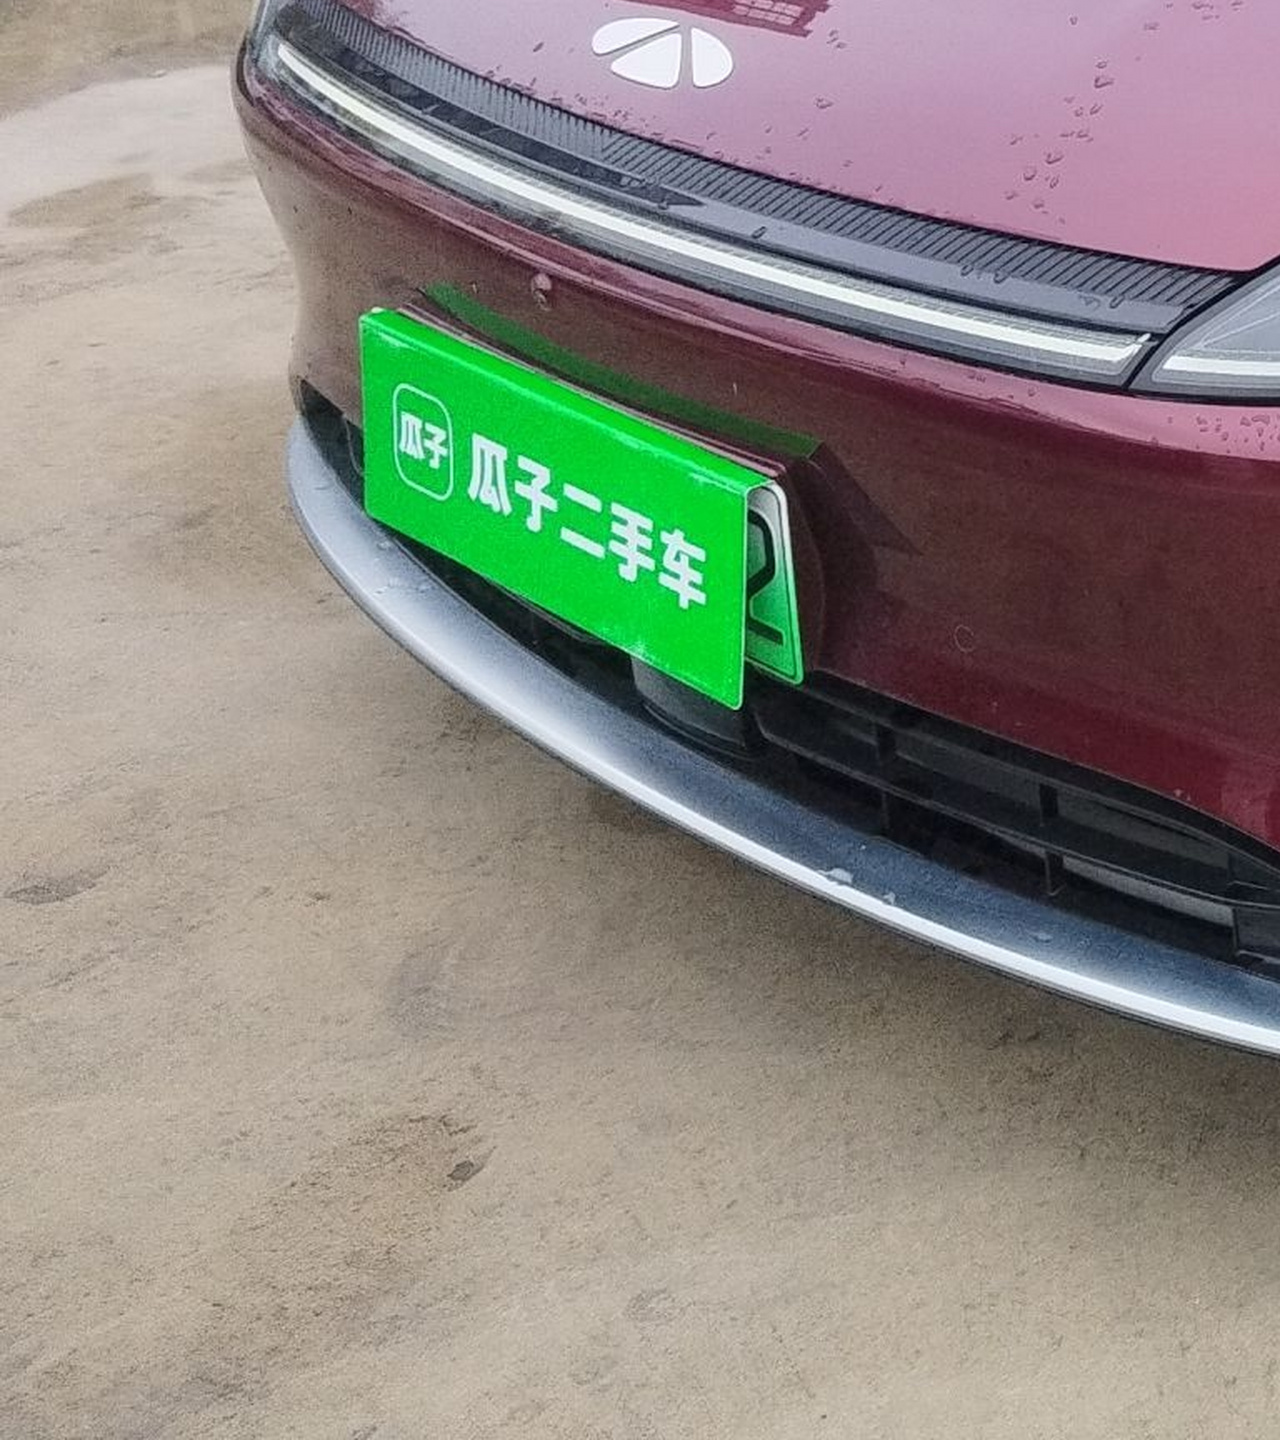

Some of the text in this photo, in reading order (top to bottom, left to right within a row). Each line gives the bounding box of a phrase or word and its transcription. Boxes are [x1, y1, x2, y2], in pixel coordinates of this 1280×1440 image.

[398, 411, 449, 470] 瓜子
[468, 433, 707, 610] 瓜子二手车
